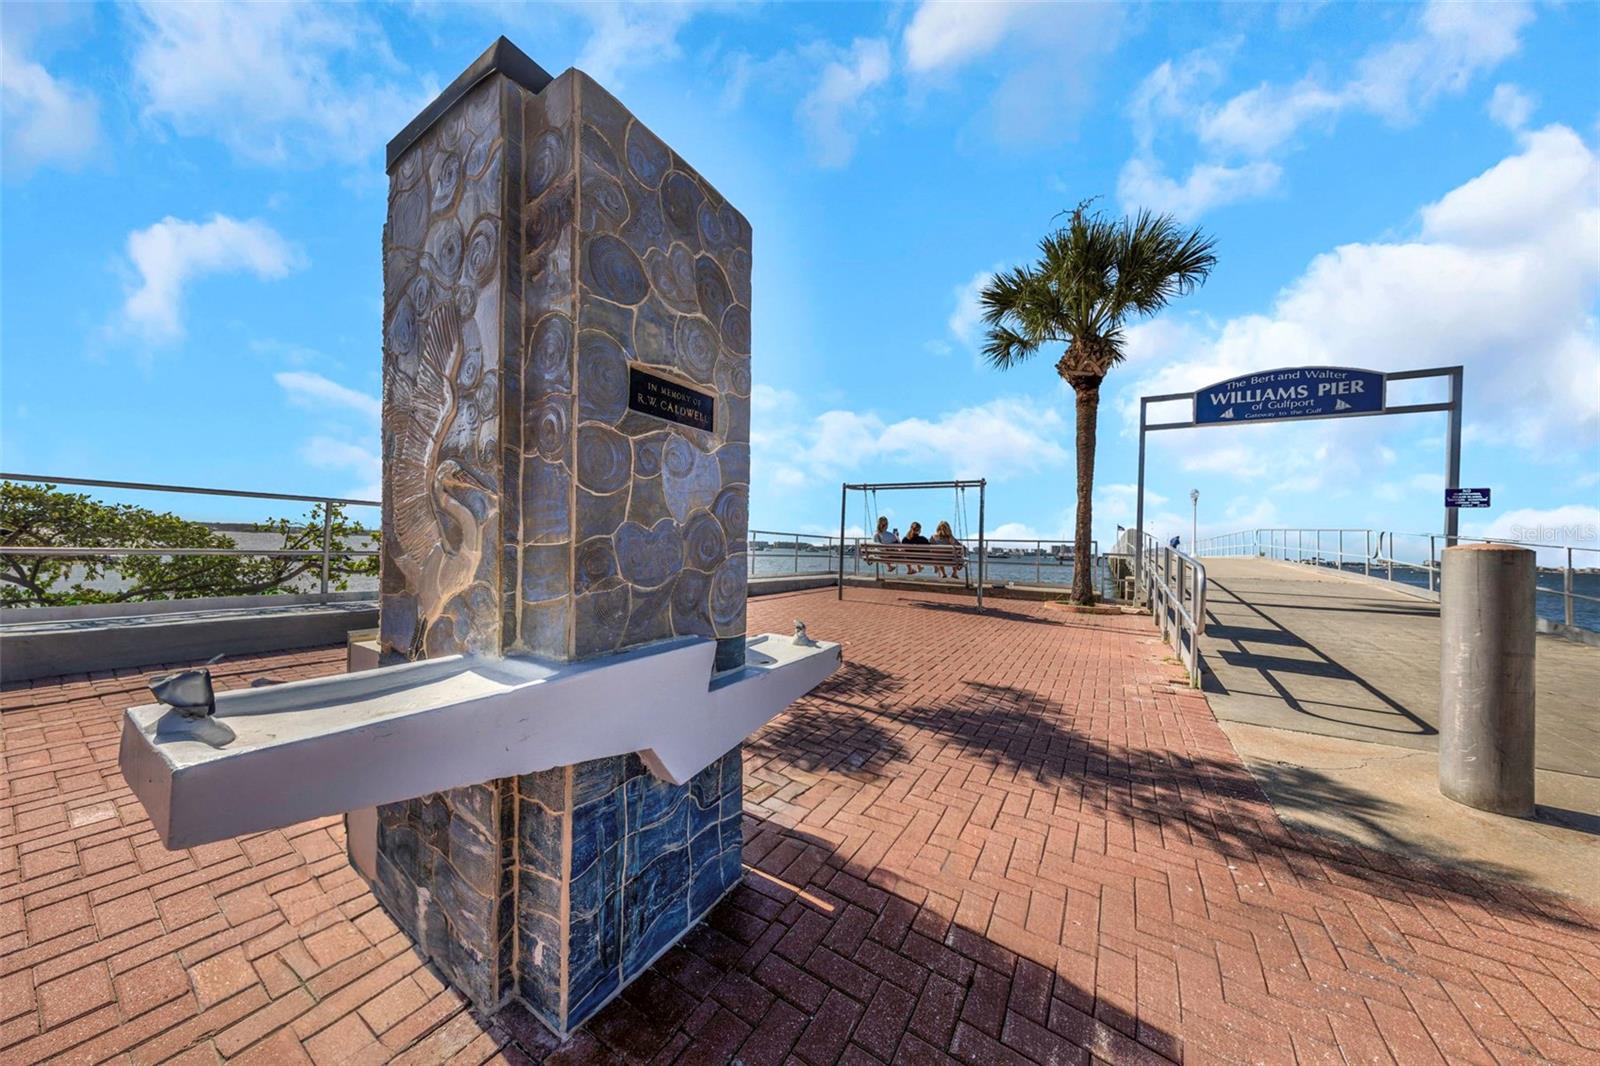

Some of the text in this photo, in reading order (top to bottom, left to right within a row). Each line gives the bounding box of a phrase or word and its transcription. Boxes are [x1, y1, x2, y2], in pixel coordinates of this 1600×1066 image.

[1226, 370, 1348, 390] The Bert and Walter
[648, 382, 701, 407] IN MEMORY OF
[1210, 380, 1364, 405] WILLIAMS PIER
[660, 400, 709, 423] CALDWELL
[1244, 411, 1275, 420] Gateway
[1306, 407, 1322, 415] Gulf
[1252, 399, 1315, 411] of Gulfport
